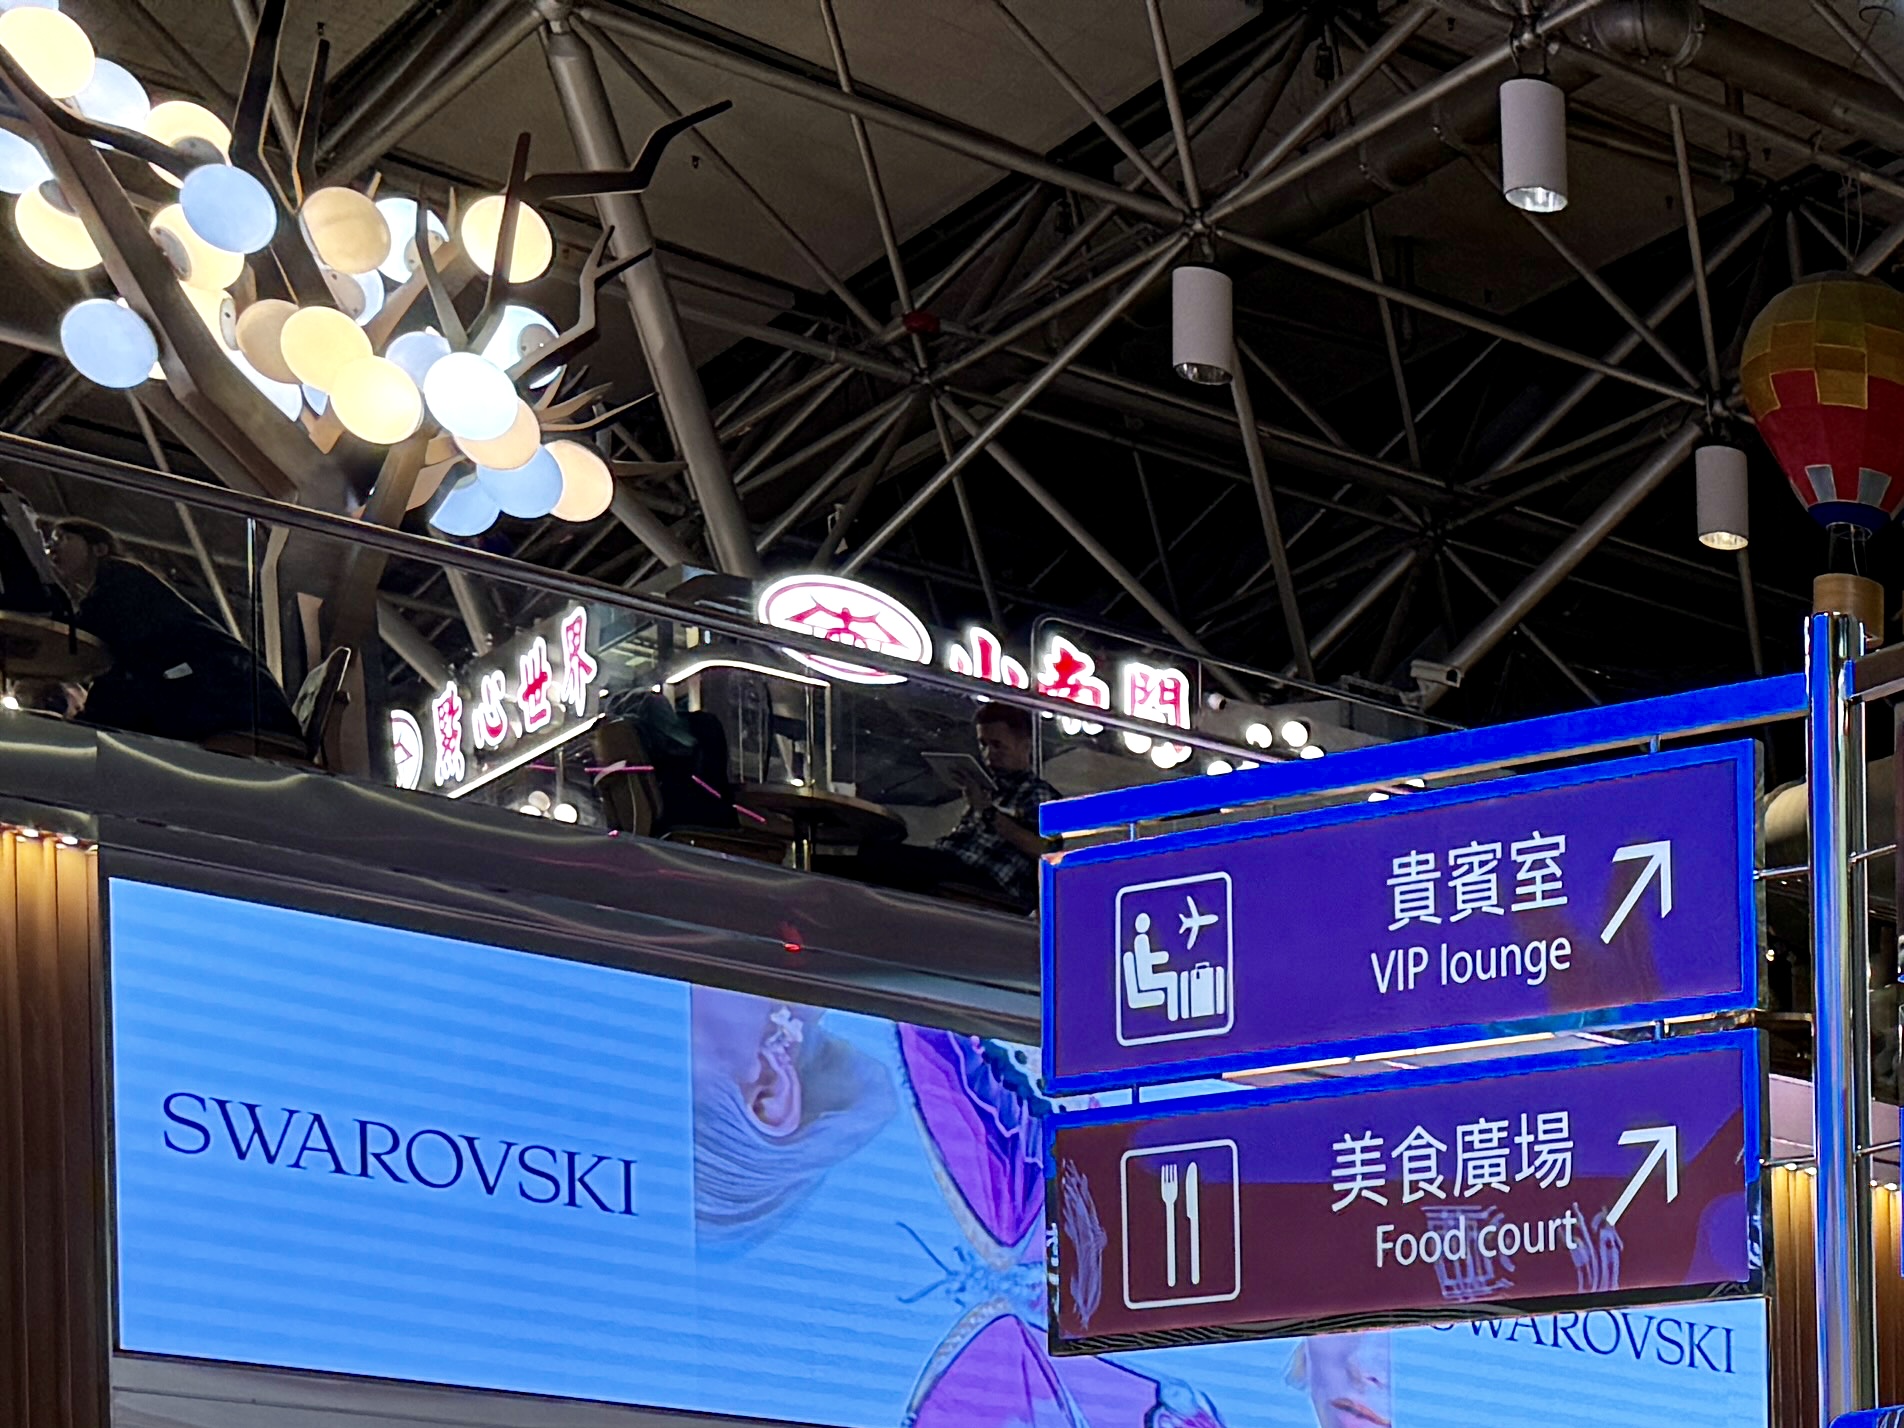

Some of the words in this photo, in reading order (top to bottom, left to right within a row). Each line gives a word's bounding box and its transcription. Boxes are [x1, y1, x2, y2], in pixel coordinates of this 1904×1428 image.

[1386, 831, 1569, 931] 貴賓室
[1371, 947, 1428, 994] VIP
[1441, 934, 1572, 986] lounge
[162, 1092, 638, 1217] SWAROVSKI
[1331, 1111, 1574, 1212] 美食廣場
[1376, 1218, 1467, 1268] Food
[1480, 1209, 1578, 1254] court
[1430, 1310, 1735, 1373] WAROVSKI
